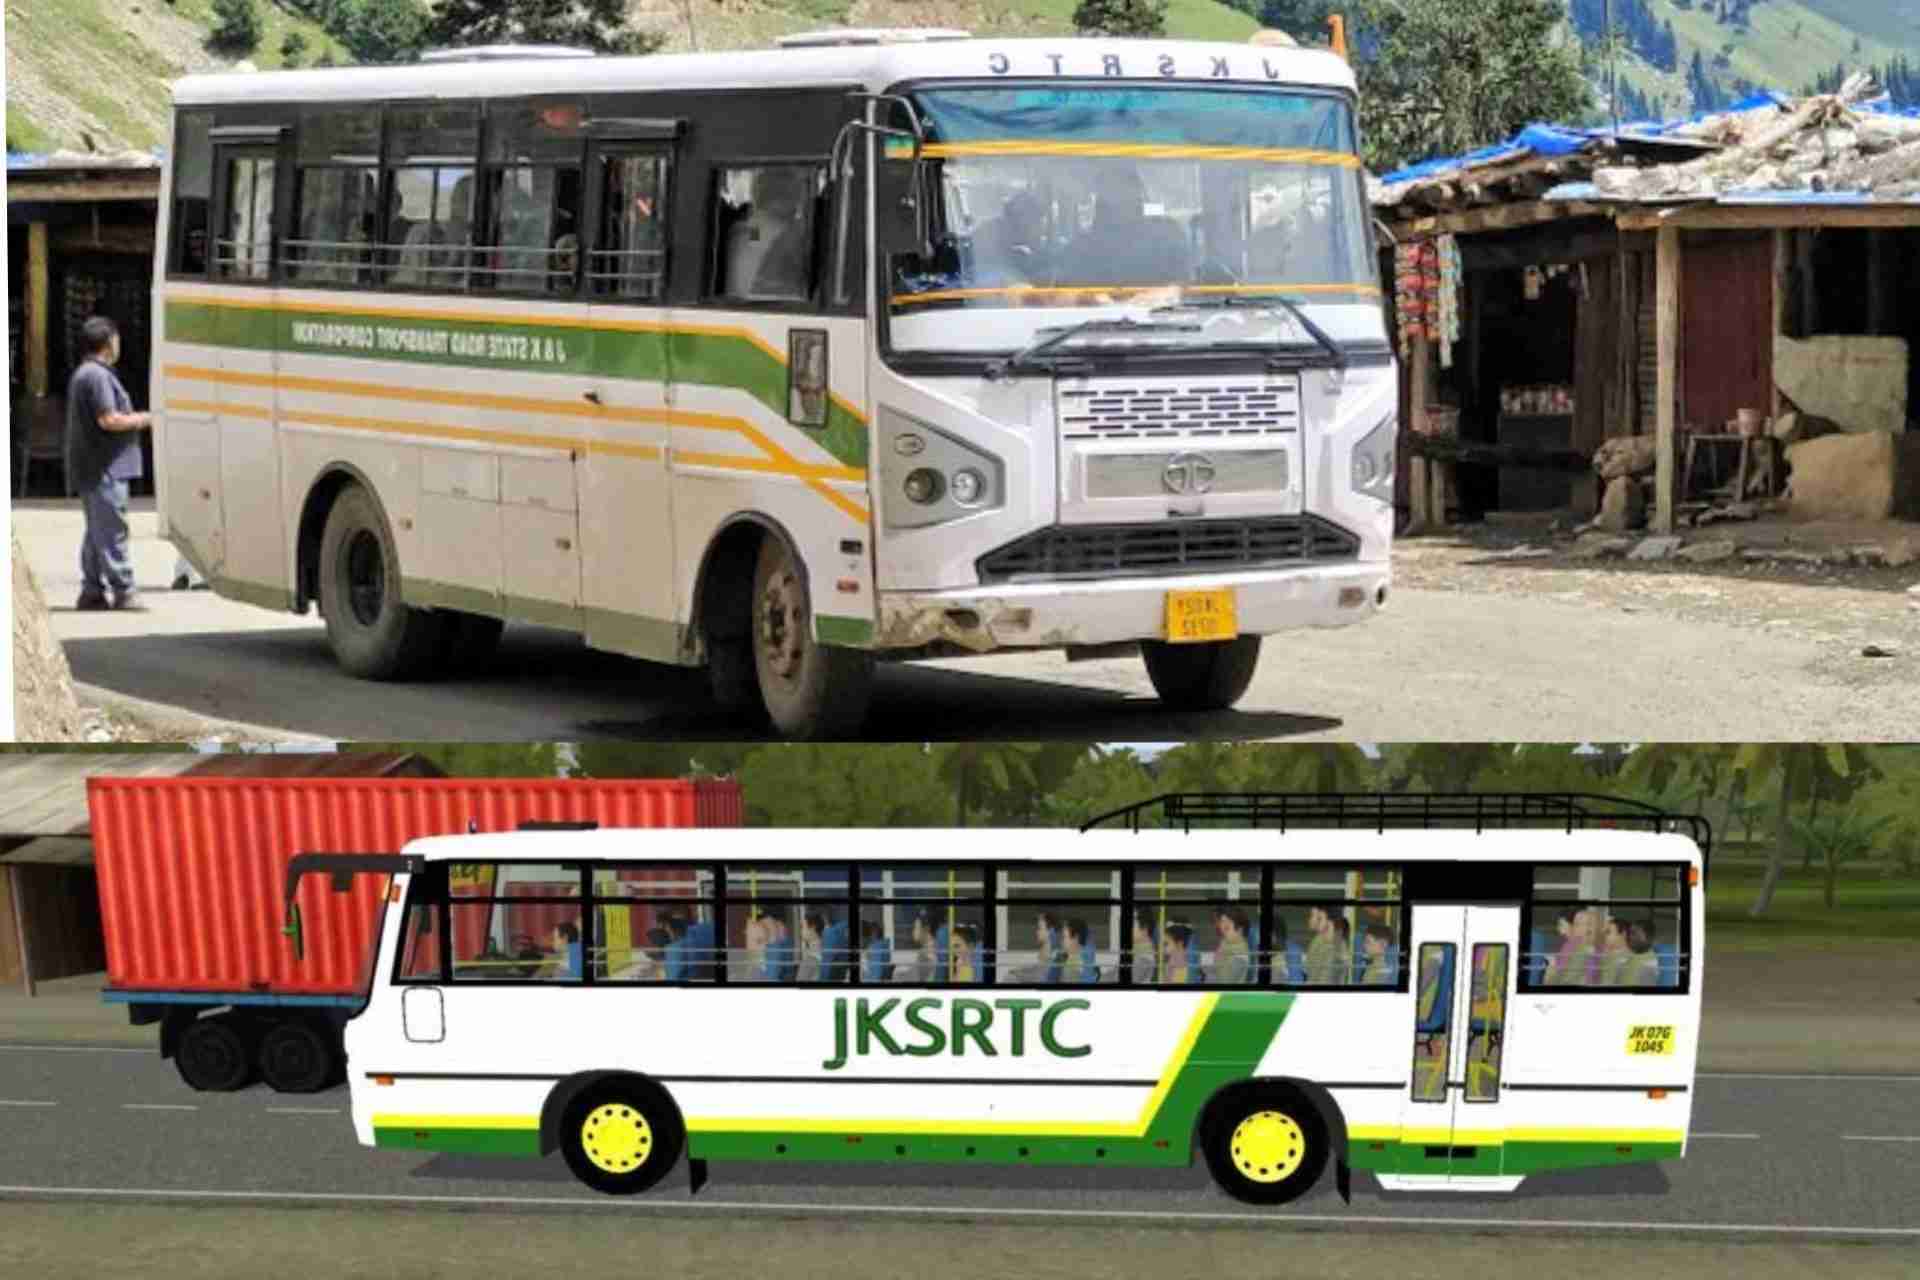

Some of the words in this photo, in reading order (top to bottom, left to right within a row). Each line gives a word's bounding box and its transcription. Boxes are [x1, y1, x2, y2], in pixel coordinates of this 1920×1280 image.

[822, 997, 1092, 1070] JKSRTC
[1629, 1026, 1647, 1039] JK
[1634, 1039, 1665, 1053] 1045
